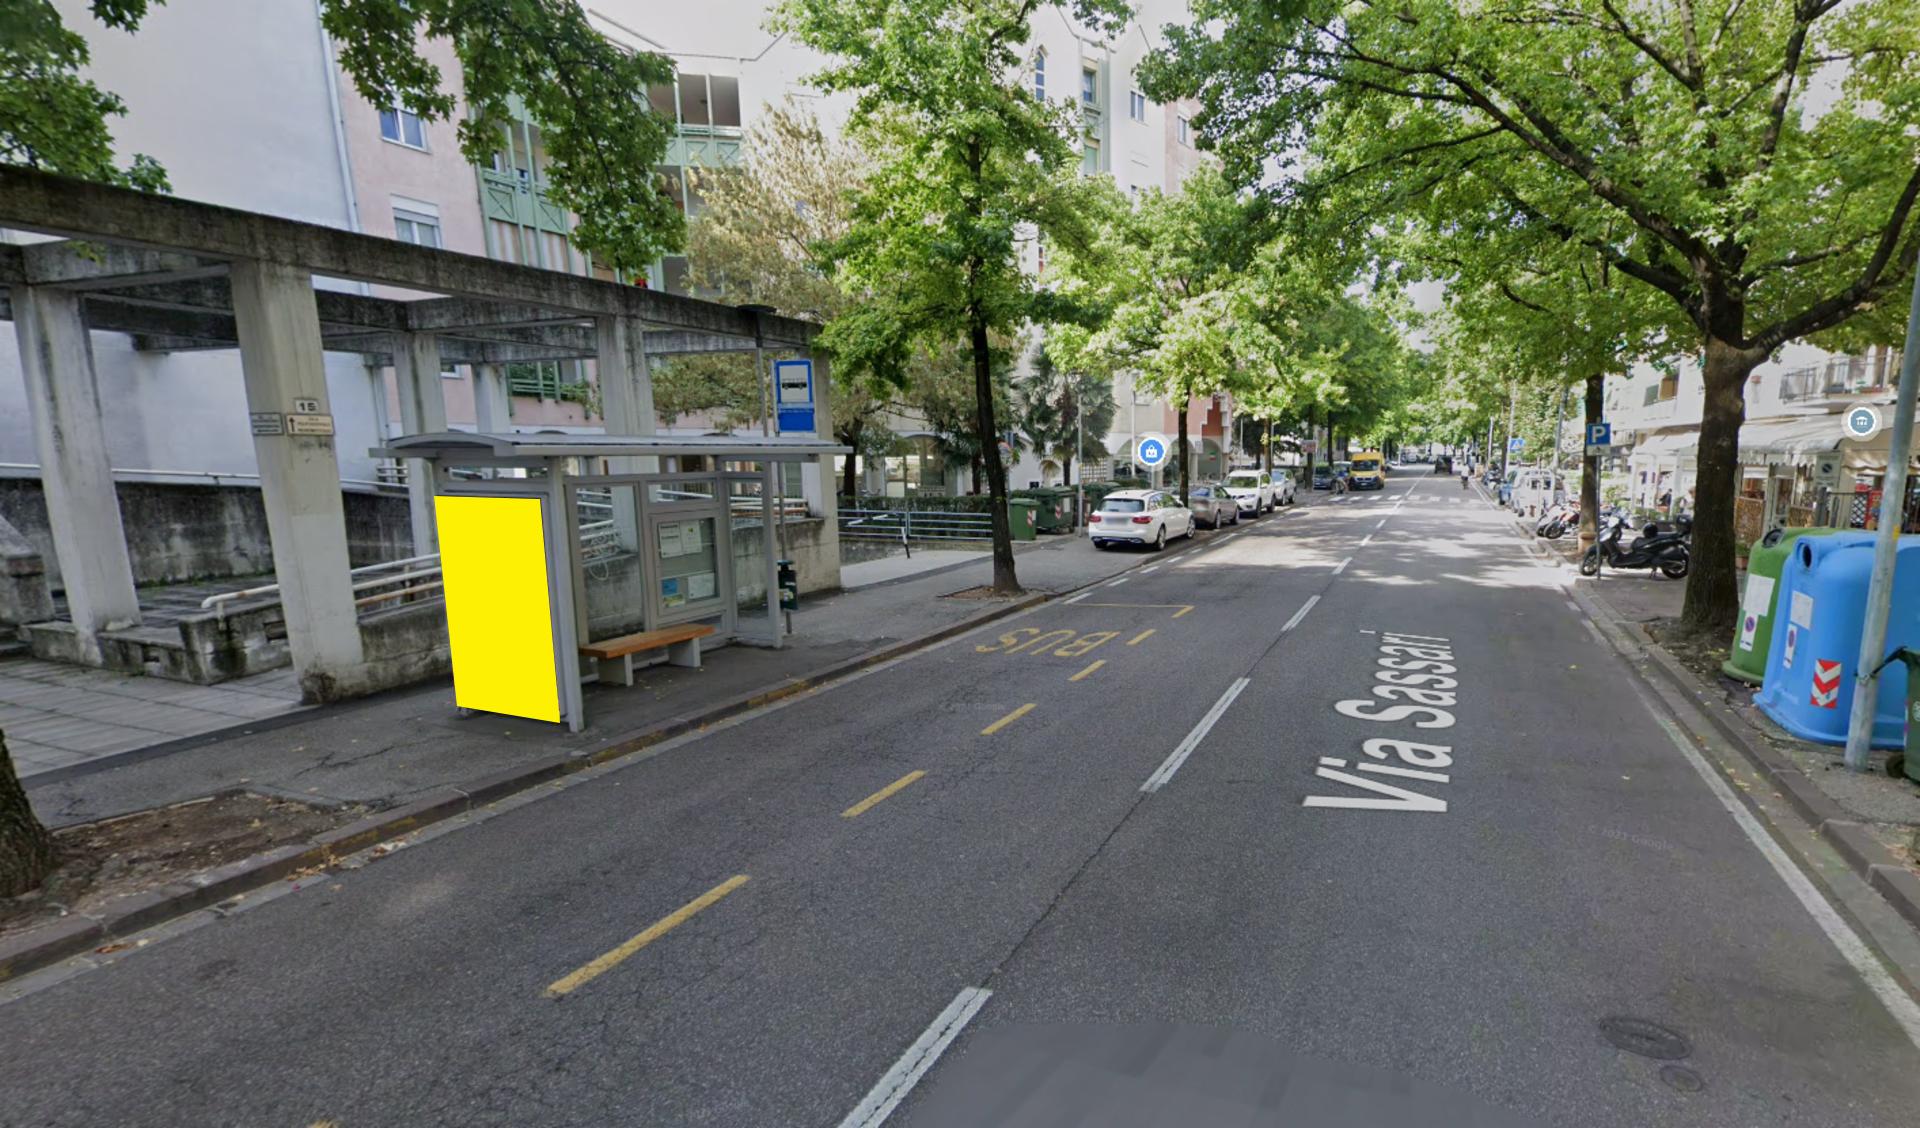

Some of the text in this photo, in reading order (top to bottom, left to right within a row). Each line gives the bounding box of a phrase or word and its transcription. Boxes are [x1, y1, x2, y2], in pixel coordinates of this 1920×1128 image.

[299, 402, 317, 411] 15
[1591, 425, 1606, 443] P
[975, 627, 1120, 657] BUS
